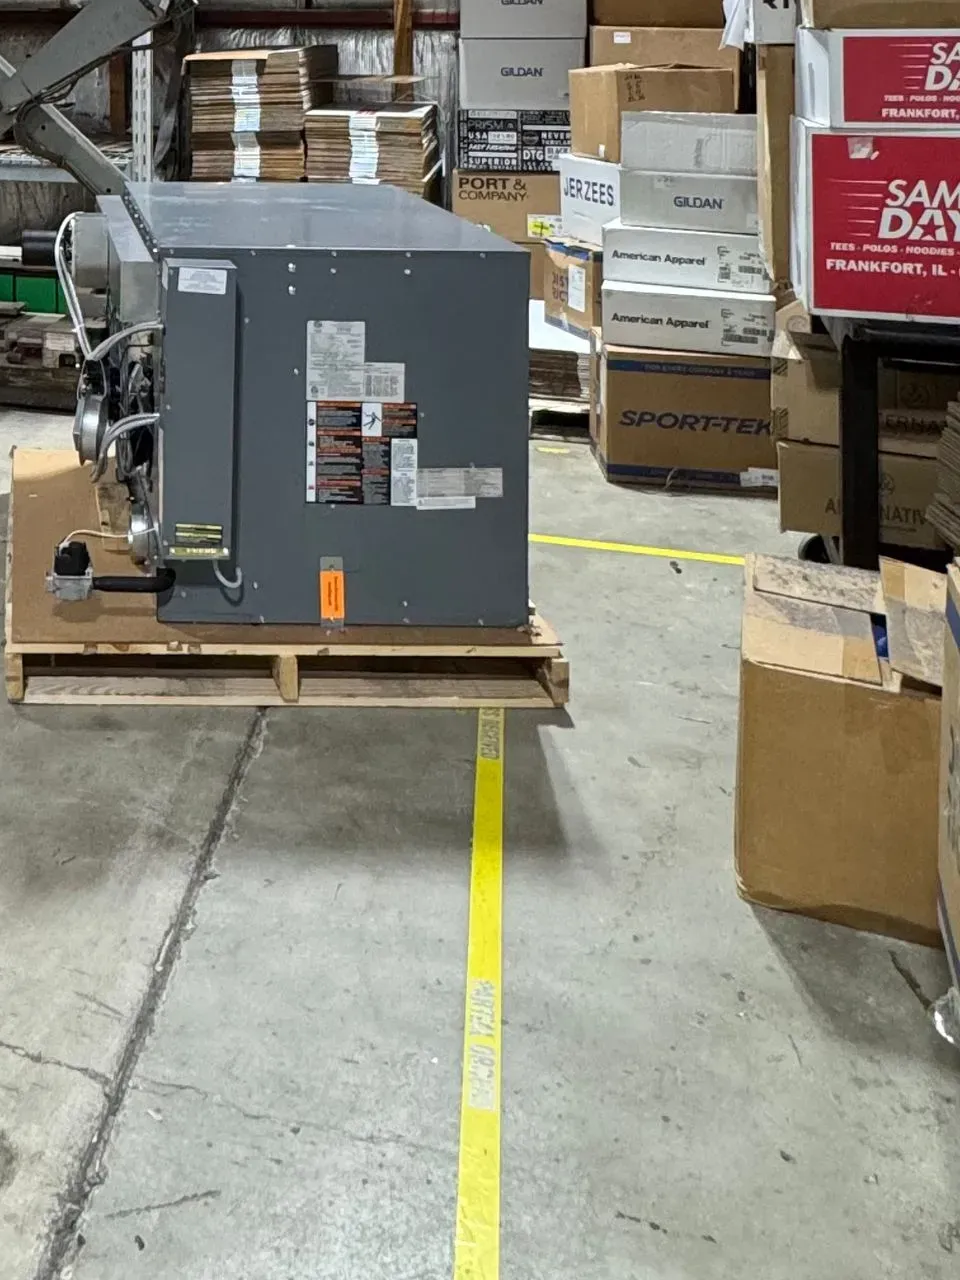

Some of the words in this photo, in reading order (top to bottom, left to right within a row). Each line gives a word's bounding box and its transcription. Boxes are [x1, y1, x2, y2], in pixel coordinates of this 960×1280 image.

[500, 67, 544, 77] GILDAN
[882, 108, 959, 120] FRANKFORT,
[468, 131, 488, 139] USA
[468, 157, 517, 165] SUPERIOR
[523, 150, 544, 161] DTG
[458, 177, 510, 190] PORT
[513, 178, 527, 191] &
[458, 190, 527, 202] COMPANY
[563, 177, 615, 207] JERZEES
[673, 196, 724, 210] GILDAN
[830, 242, 855, 251] TEES
[862, 244, 898, 253] POLOS
[905, 246, 955, 256] HOODIES
[612, 250, 662, 263] American
[664, 254, 706, 266] Apparel
[826, 258, 927, 277] FRANKFORT,
[932, 264, 948, 276] IL
[612, 312, 663, 325] American
[665, 316, 710, 329] Apparel
[619, 410, 771, 436] SPORT-TEK
